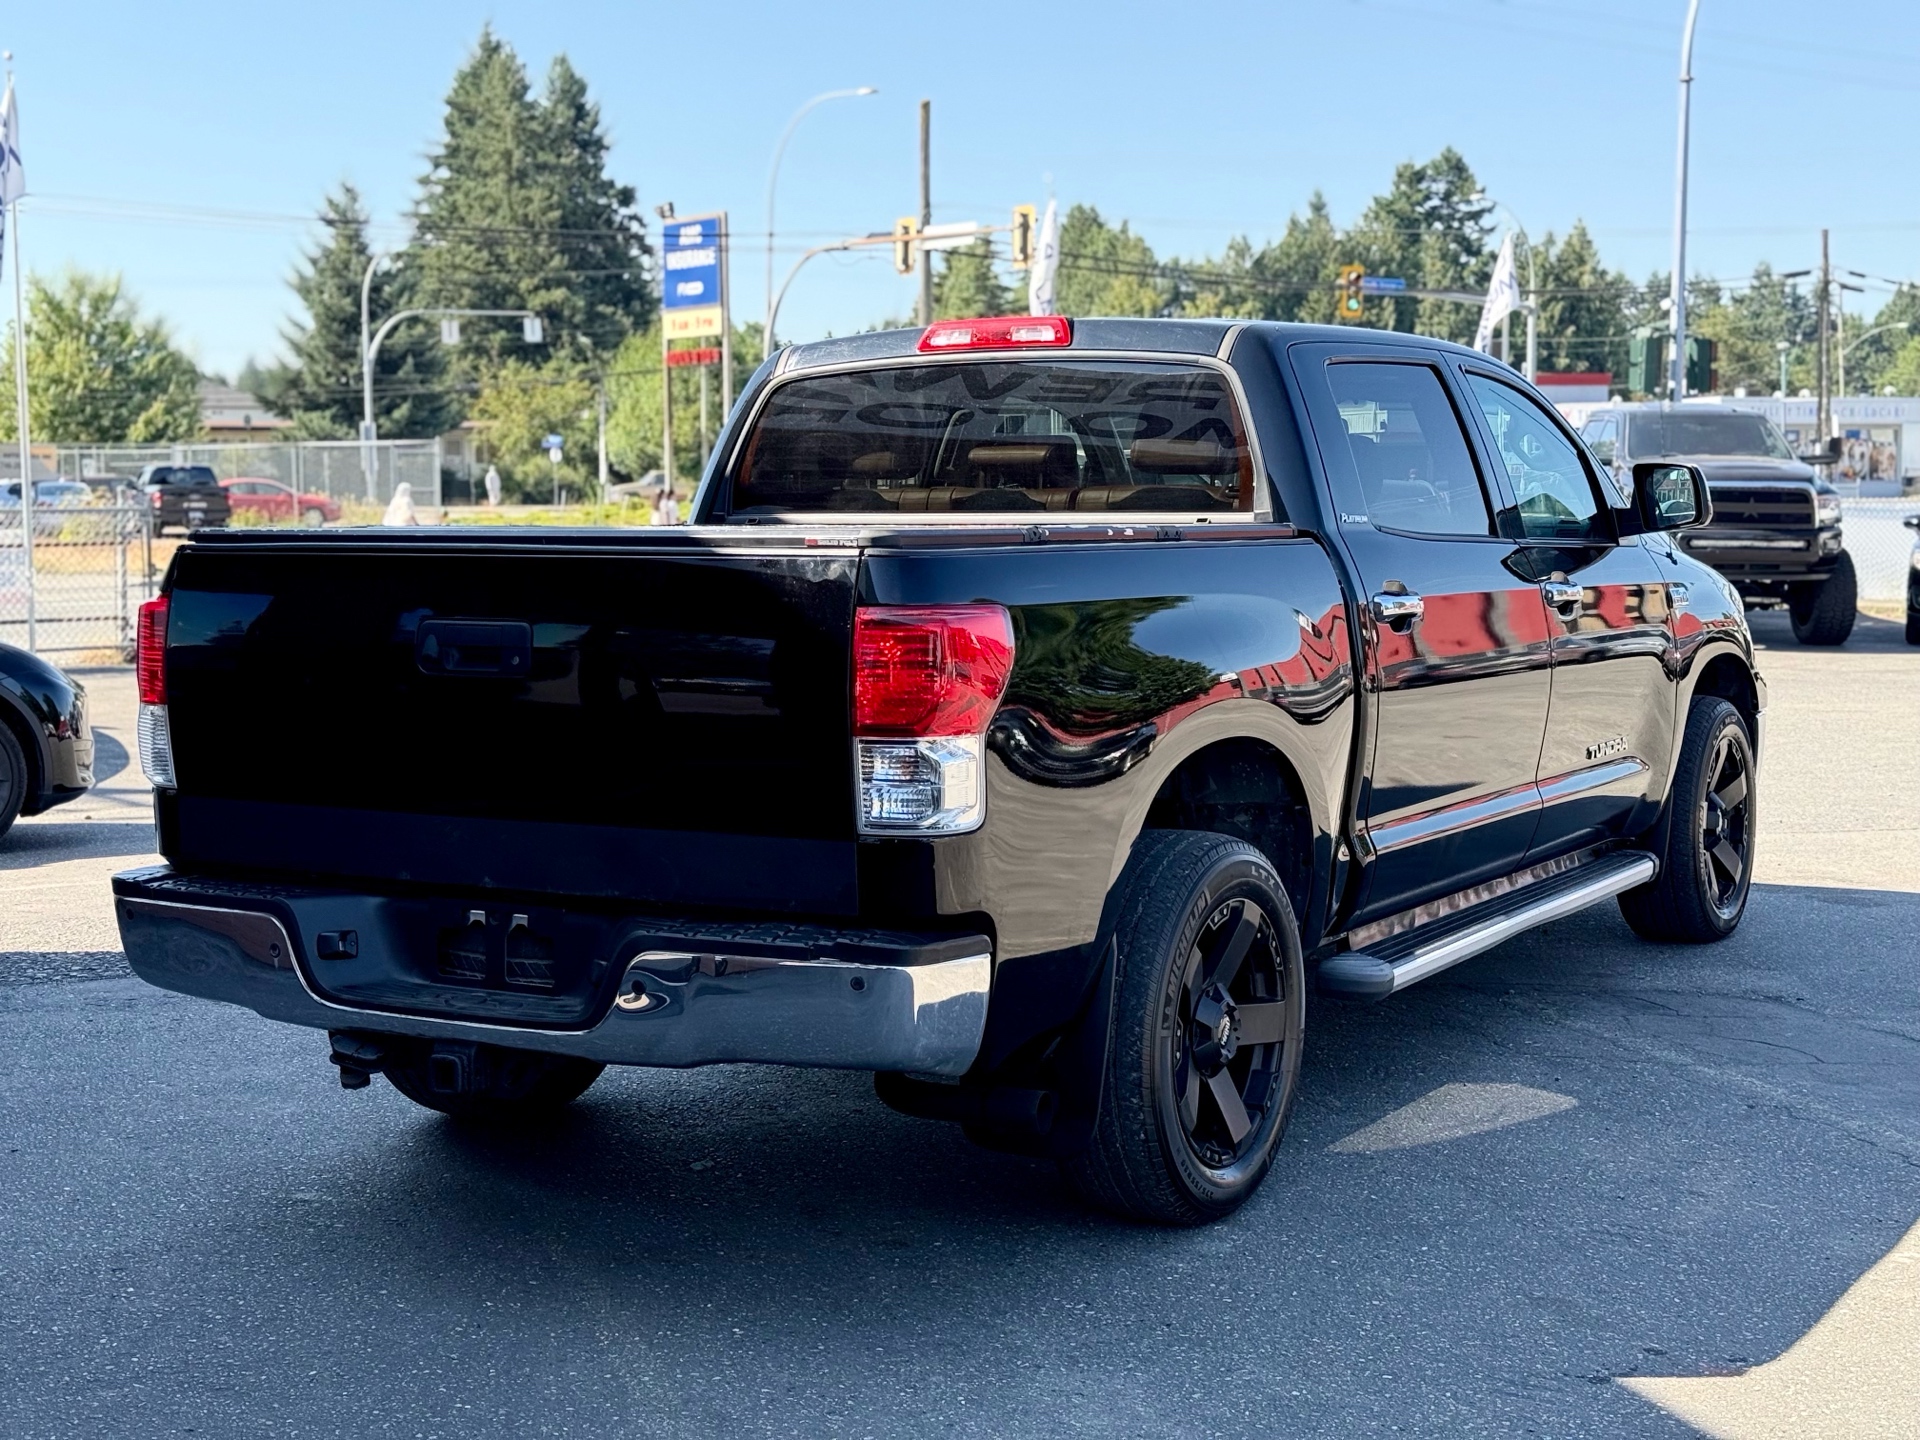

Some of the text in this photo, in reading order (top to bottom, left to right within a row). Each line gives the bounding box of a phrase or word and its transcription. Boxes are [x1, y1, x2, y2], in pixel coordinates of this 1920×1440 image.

[1586, 736, 1629, 760] TUNDRA
[1251, 865, 1276, 889] LTX
[1167, 891, 1208, 999] MICHELIN
